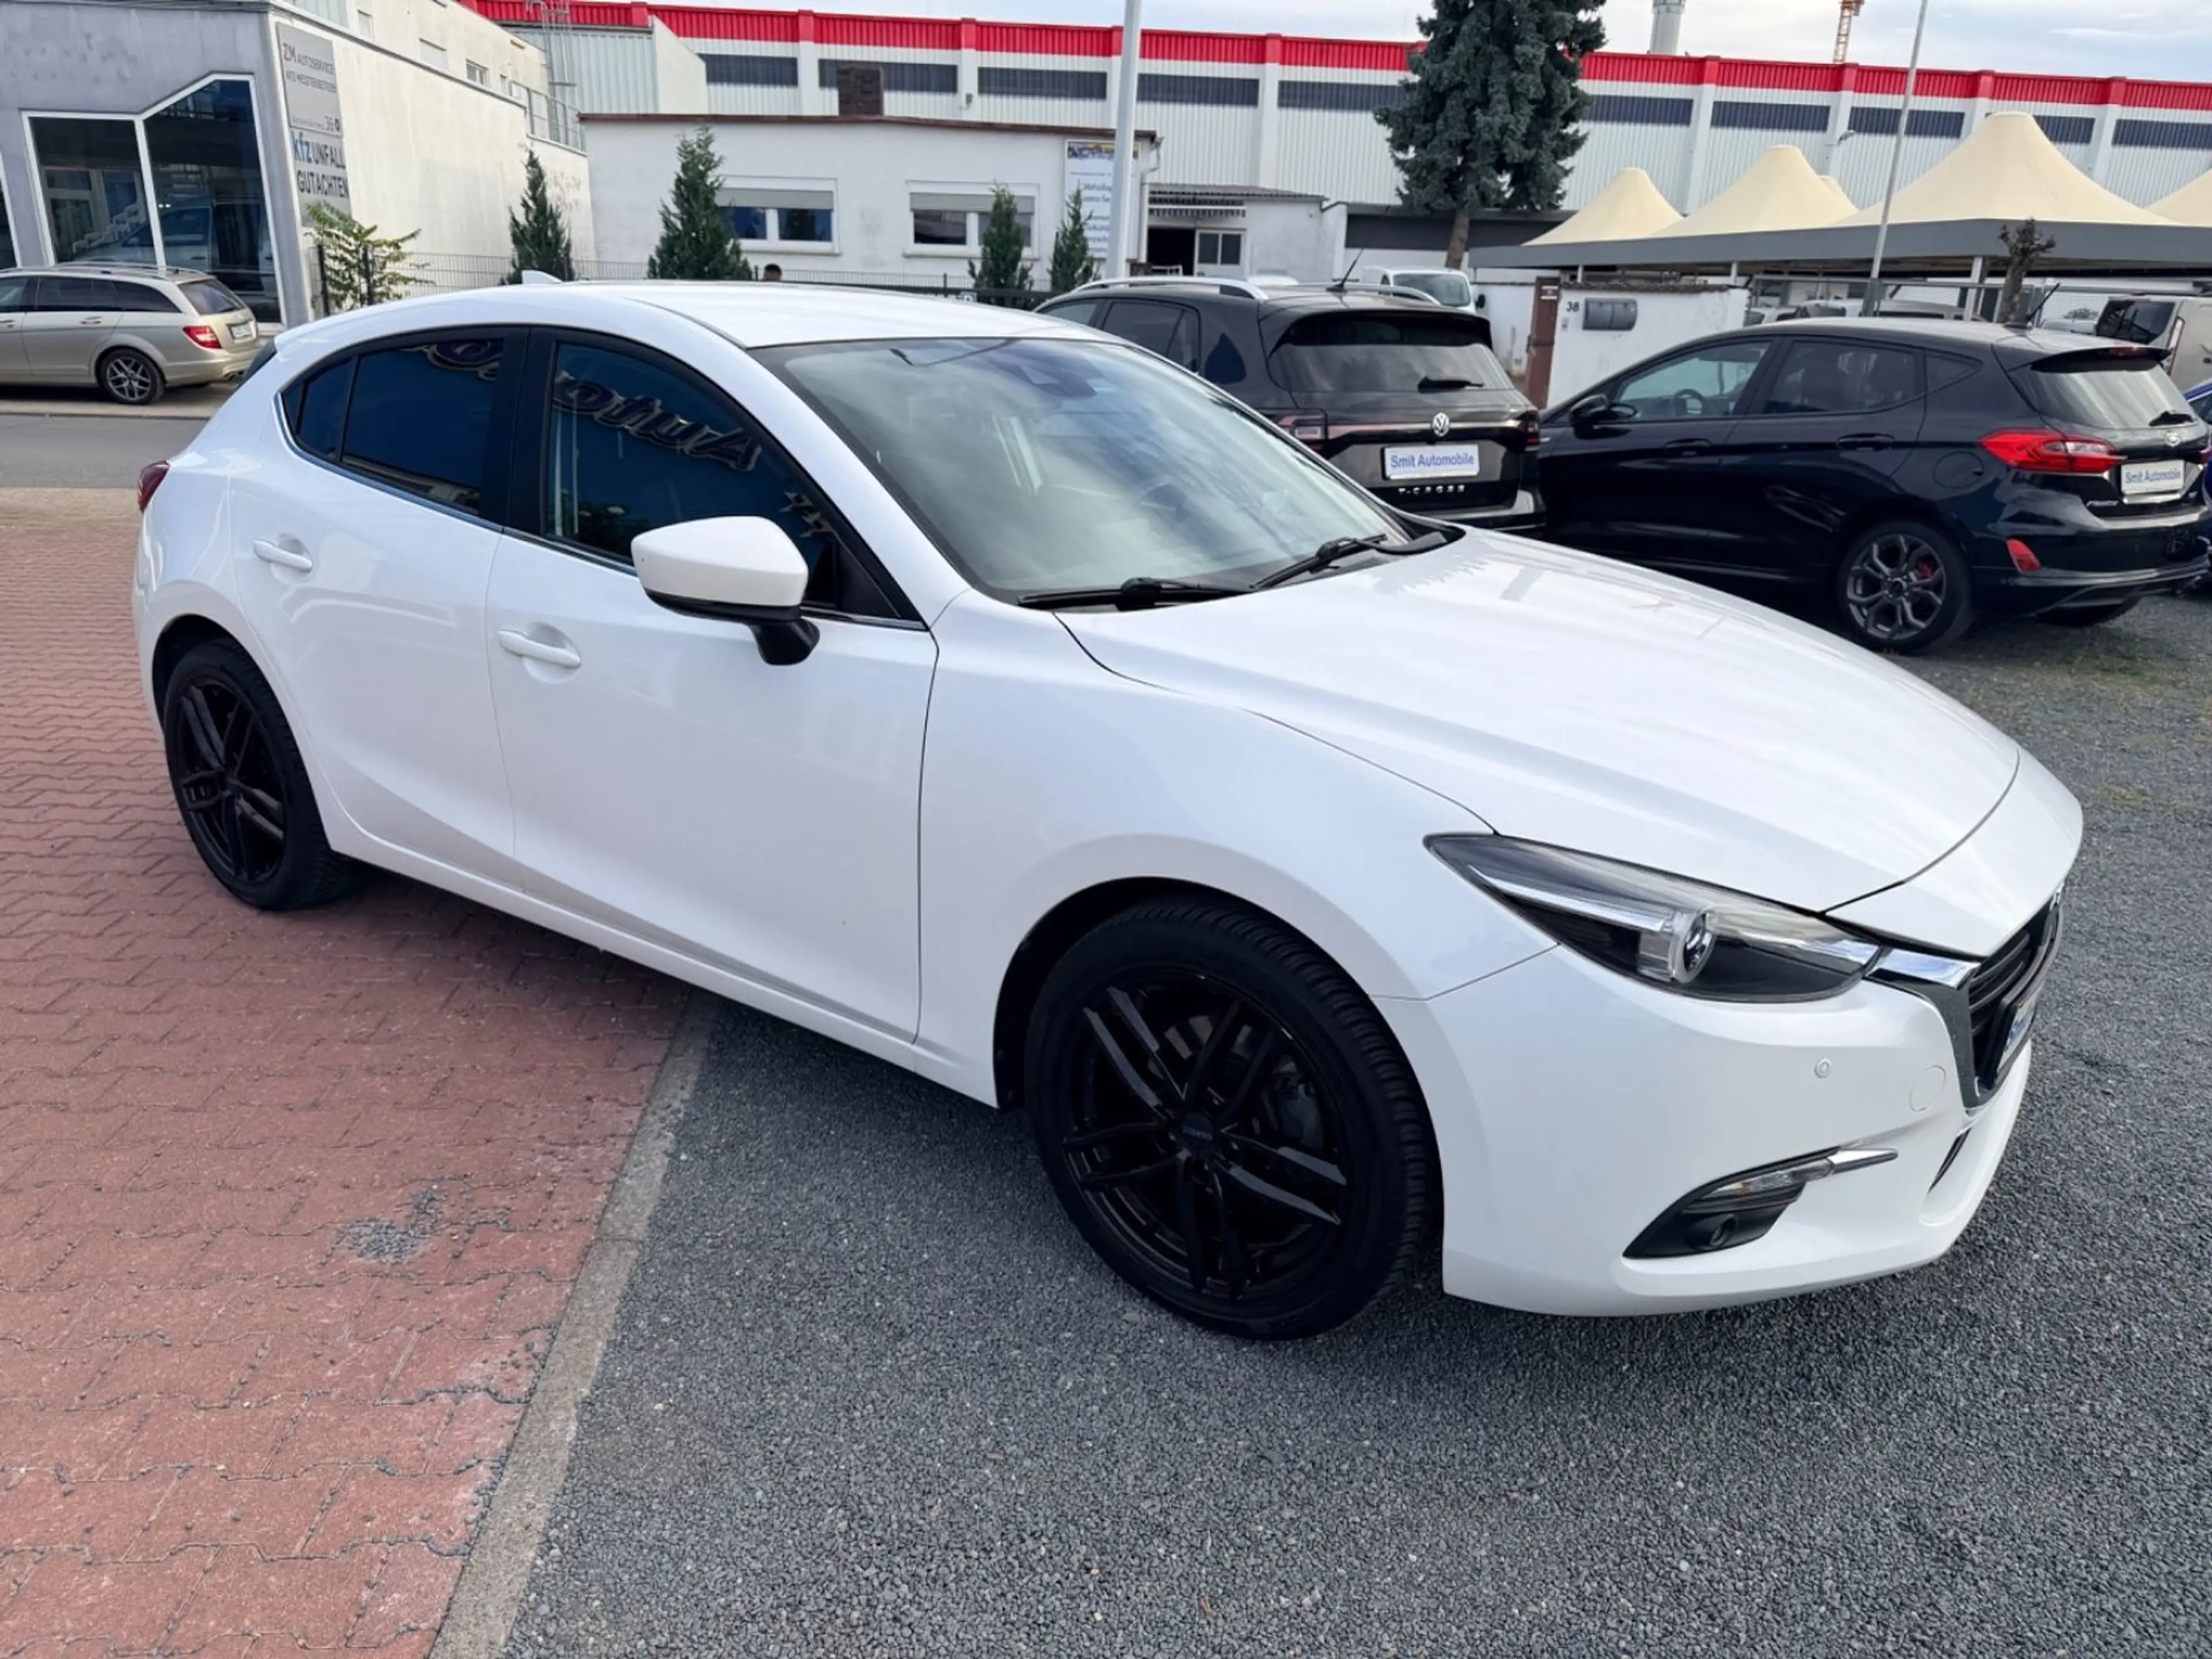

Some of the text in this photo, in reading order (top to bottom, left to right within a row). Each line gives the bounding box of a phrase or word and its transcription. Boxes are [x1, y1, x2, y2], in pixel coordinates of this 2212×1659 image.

[297, 170, 349, 199] GUTACHTEN
[1566, 301, 1580, 312] 38
[1391, 452, 1474, 469] Smit Automobile
